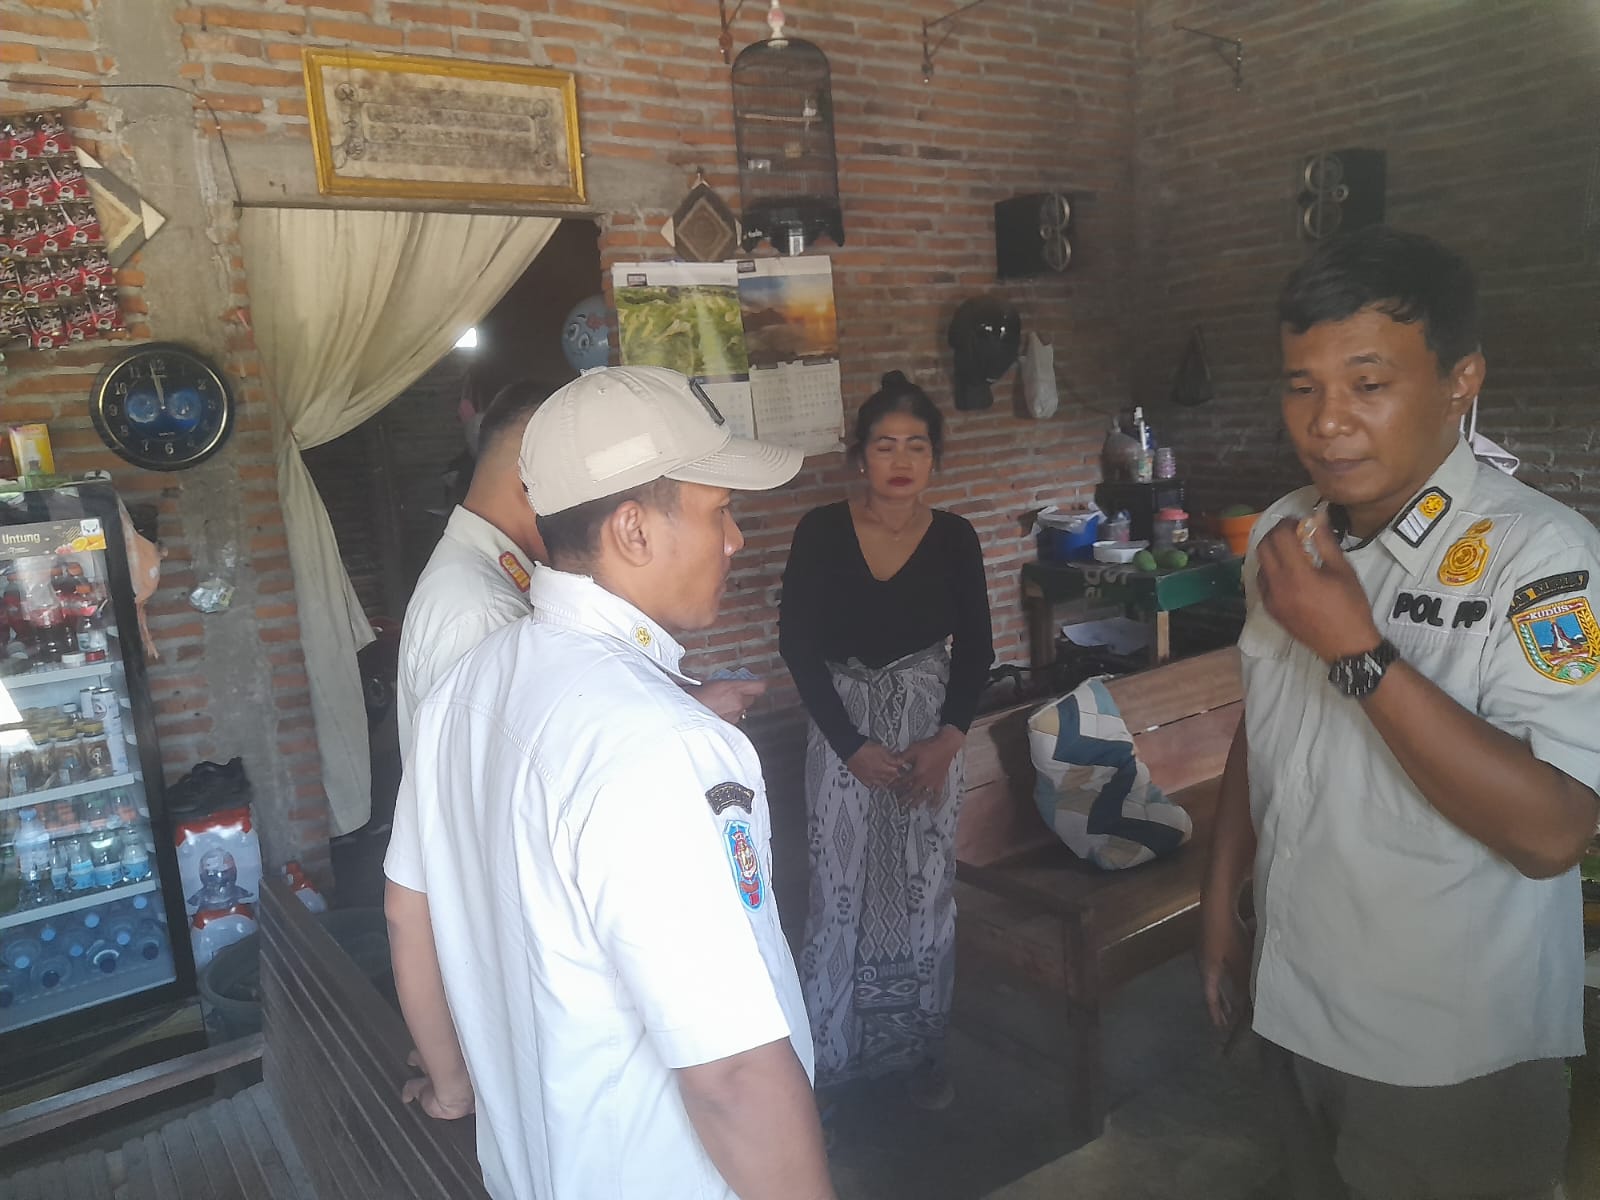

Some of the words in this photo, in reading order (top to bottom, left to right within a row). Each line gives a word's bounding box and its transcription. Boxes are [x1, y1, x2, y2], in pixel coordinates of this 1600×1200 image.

[114, 381, 128, 396] 10
[164, 442, 175, 455] 6
[2, 533, 41, 545] Untung
[1393, 592, 1444, 627] POL
[1451, 600, 1488, 629] PP
[1529, 604, 1570, 620] KUDUS
